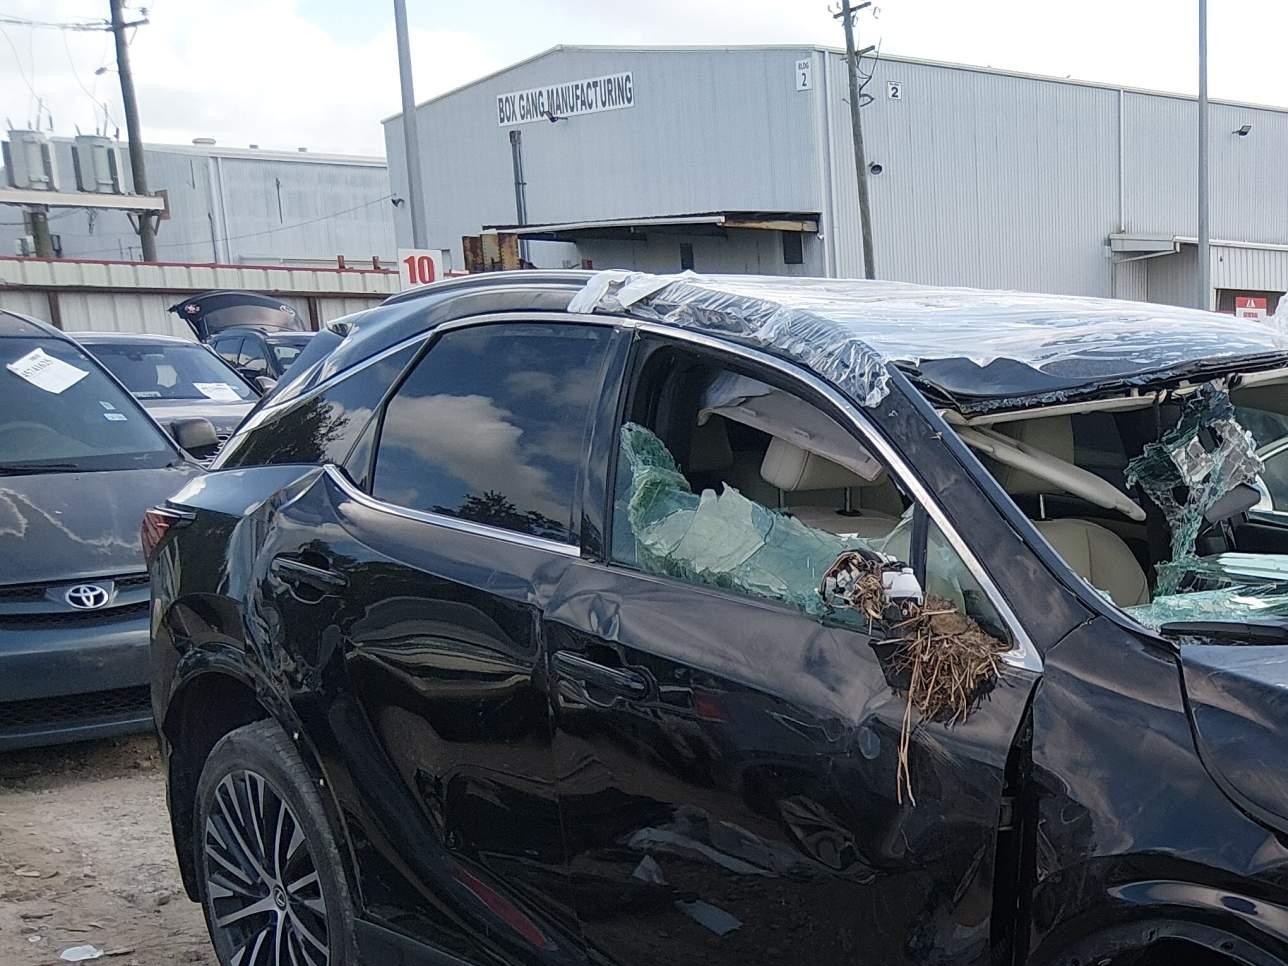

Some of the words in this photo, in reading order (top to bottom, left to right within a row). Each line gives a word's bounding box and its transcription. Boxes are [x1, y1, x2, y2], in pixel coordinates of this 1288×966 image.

[801, 72, 808, 87] 2
[498, 95, 518, 123] BOX
[519, 89, 545, 120] GANG
[546, 74, 633, 116] MANUFACTURING
[890, 86, 899, 98] 2
[403, 255, 435, 284] 10
